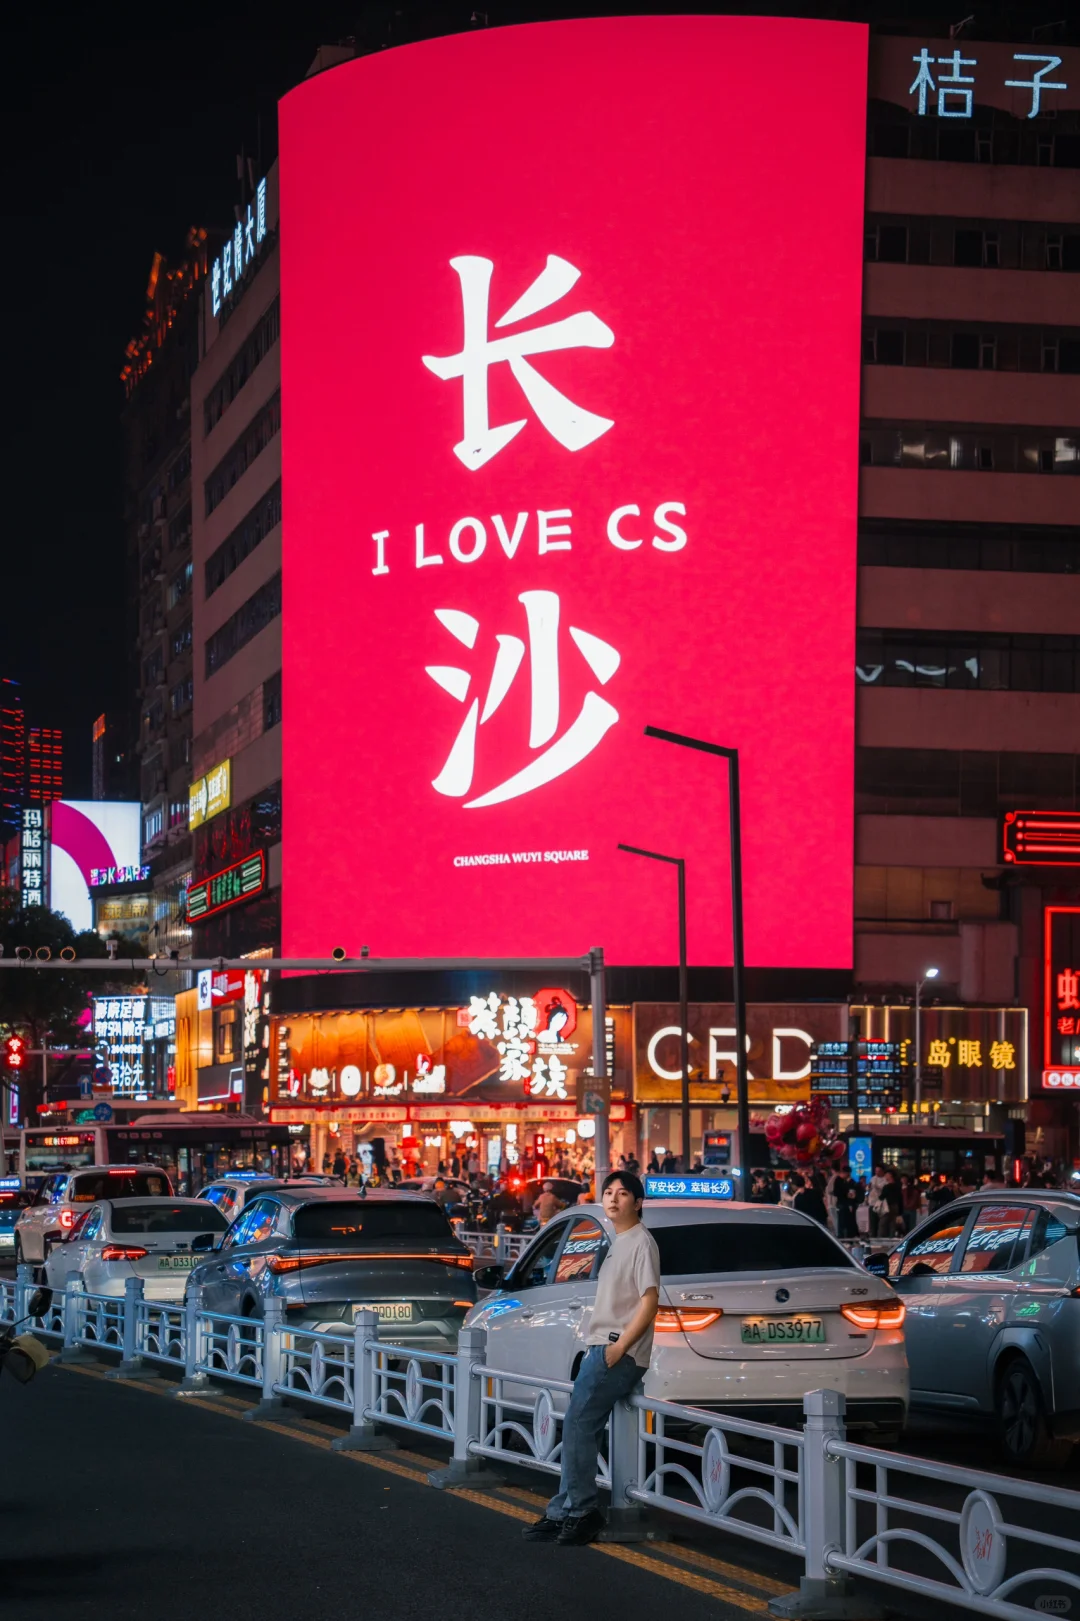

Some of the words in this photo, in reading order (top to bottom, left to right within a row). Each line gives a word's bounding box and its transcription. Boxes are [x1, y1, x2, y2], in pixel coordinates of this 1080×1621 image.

[909, 48, 1067, 119] 桔子
[422, 254, 615, 471] 长
[371, 530, 389, 575] I
[415, 509, 572, 568] LOVE
[606, 502, 687, 552] CS
[425, 590, 620, 809] 沙
[453, 854, 511, 867] CHANGSHA
[512, 851, 542, 863] WUYI
[543, 850, 589, 863] SQUARE
[647, 1026, 818, 1080] CRD
[900, 1038, 1016, 1069] 岛眼镜
[648, 1181, 687, 1193] 平安长沙
[690, 1181, 731, 1195] 幸福长沙
[173, 1257, 203, 1267] D3310
[767, 1320, 822, 1339] DS3977
